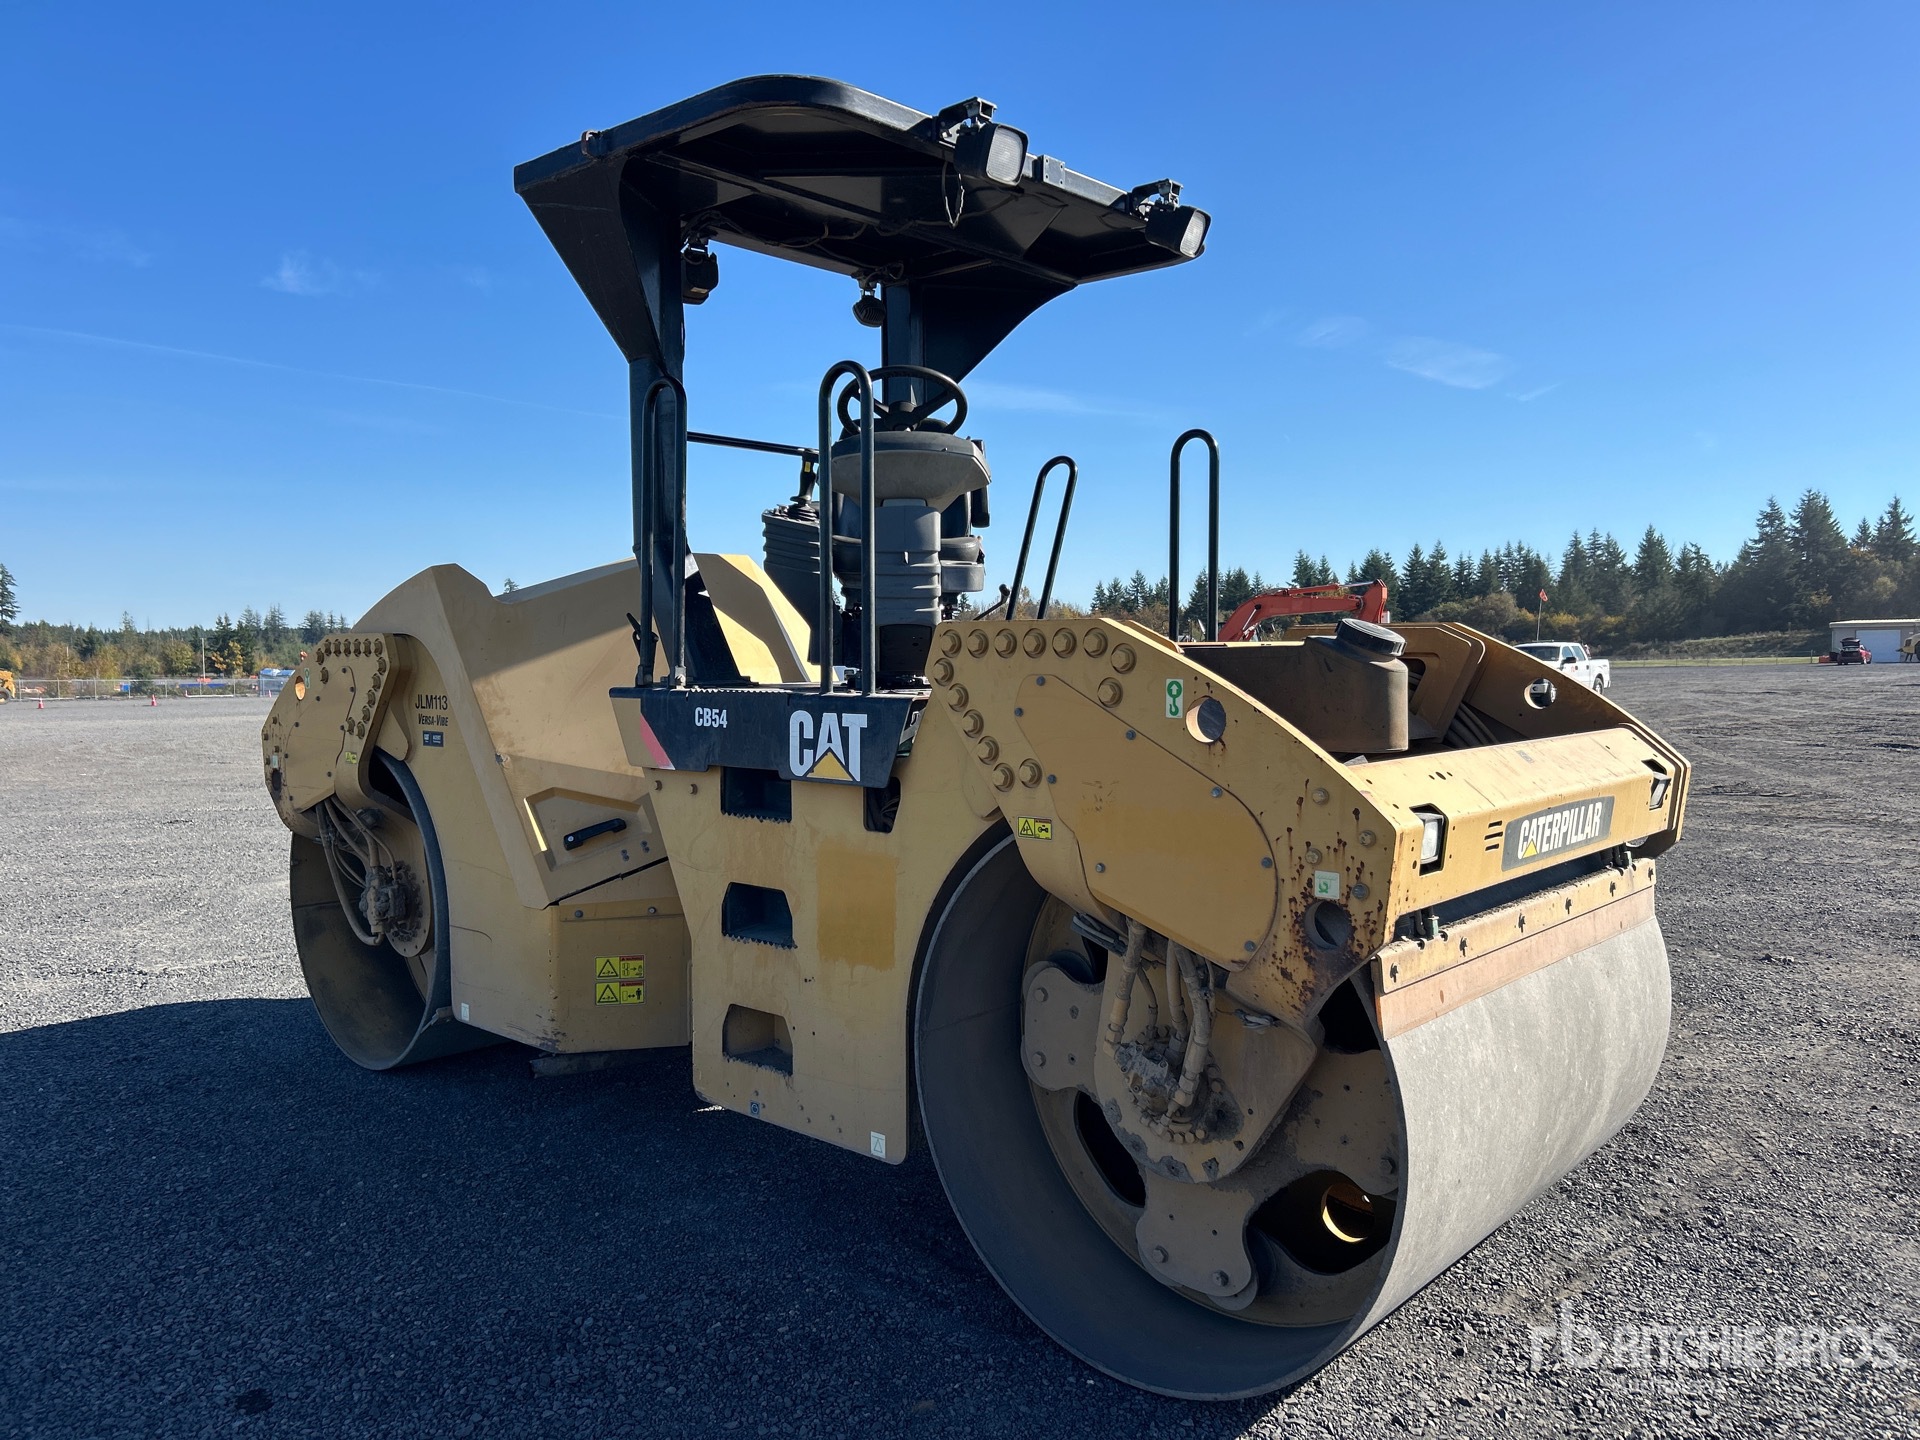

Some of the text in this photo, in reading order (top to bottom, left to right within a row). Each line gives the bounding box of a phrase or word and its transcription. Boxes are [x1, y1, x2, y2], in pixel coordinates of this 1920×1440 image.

[415, 693, 448, 710] JLM113
[694, 707, 728, 728] CB54
[789, 710, 868, 782] CAT
[1517, 801, 1603, 860] CATERPILLAR
